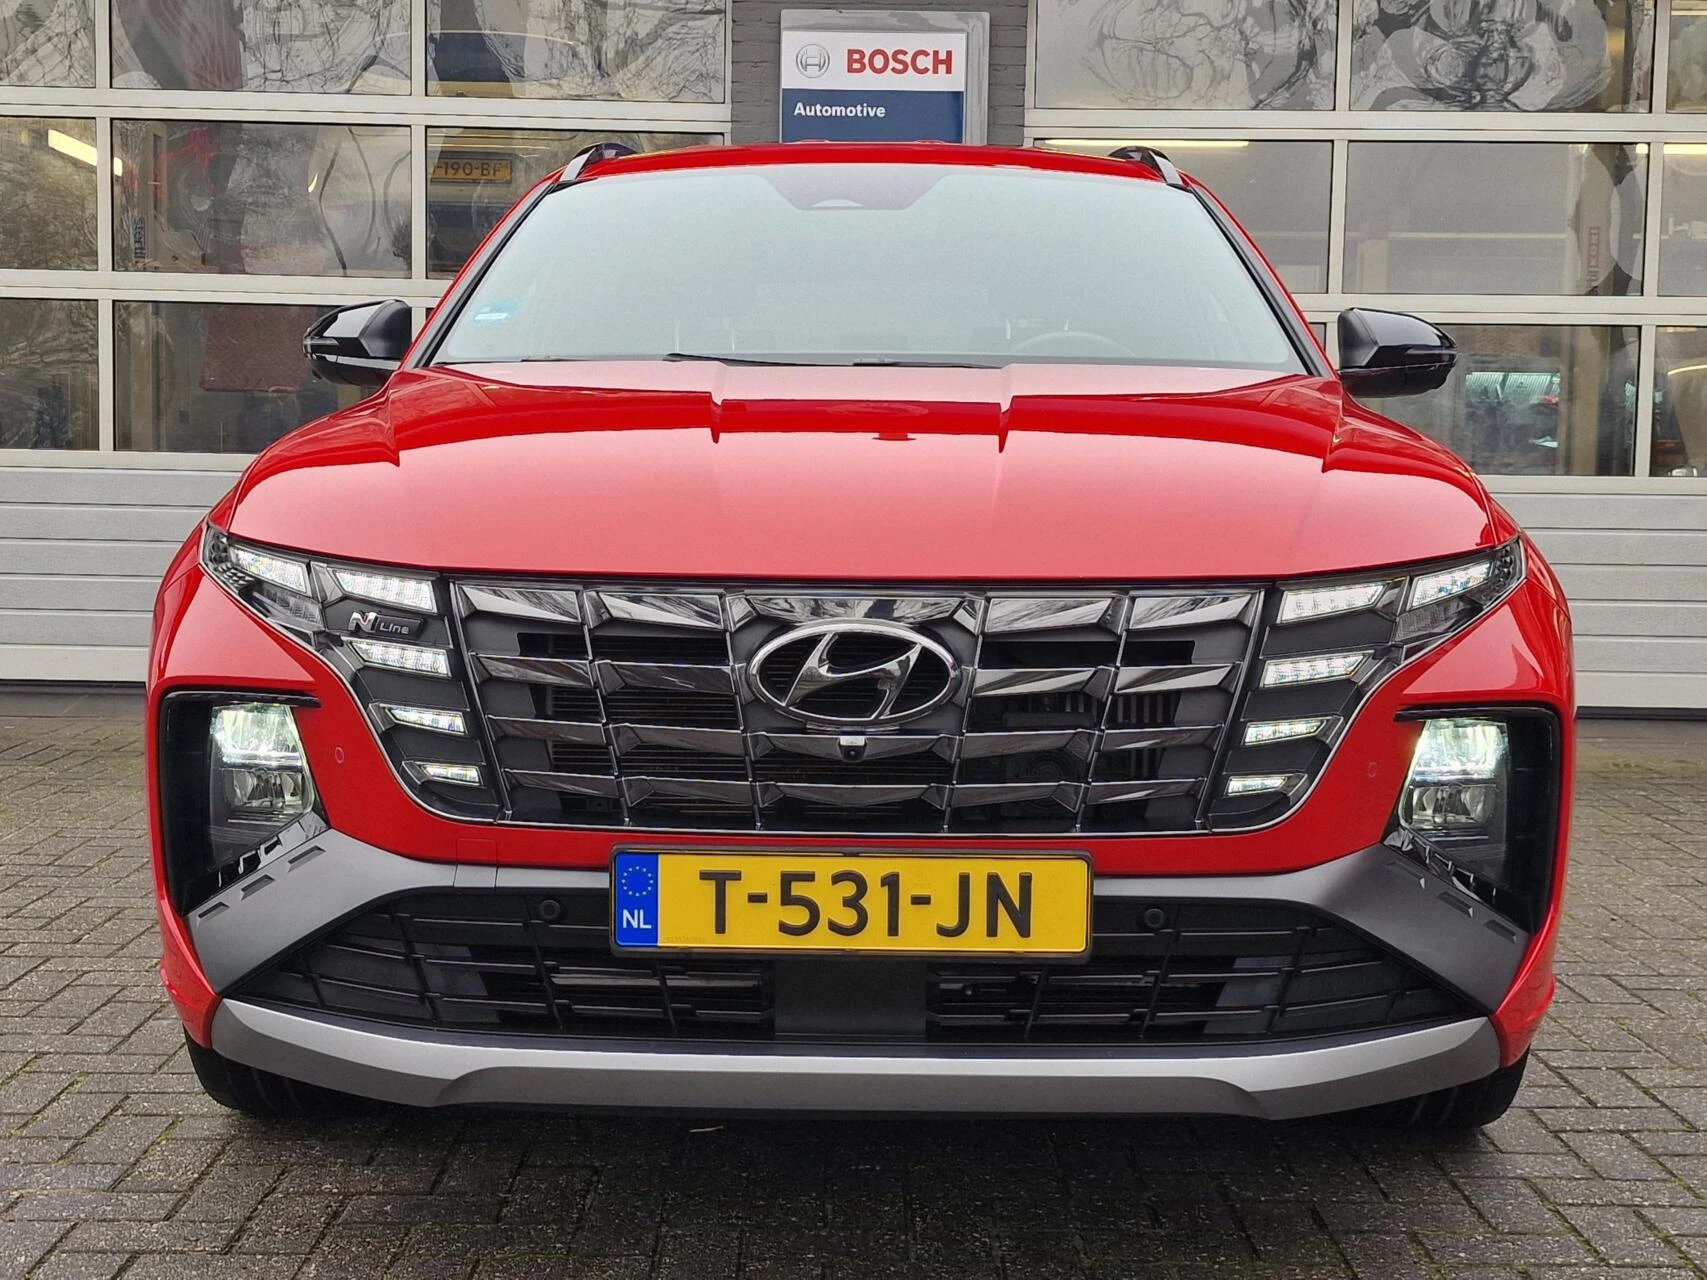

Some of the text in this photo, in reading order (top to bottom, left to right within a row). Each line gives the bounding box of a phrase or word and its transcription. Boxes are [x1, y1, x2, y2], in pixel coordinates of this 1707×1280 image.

[846, 48, 953, 75] BOSCH
[793, 102, 886, 118] Automotive
[348, 611, 378, 632] N
[698, 869, 1033, 938] T-531-JN
[622, 908, 652, 930] NL
